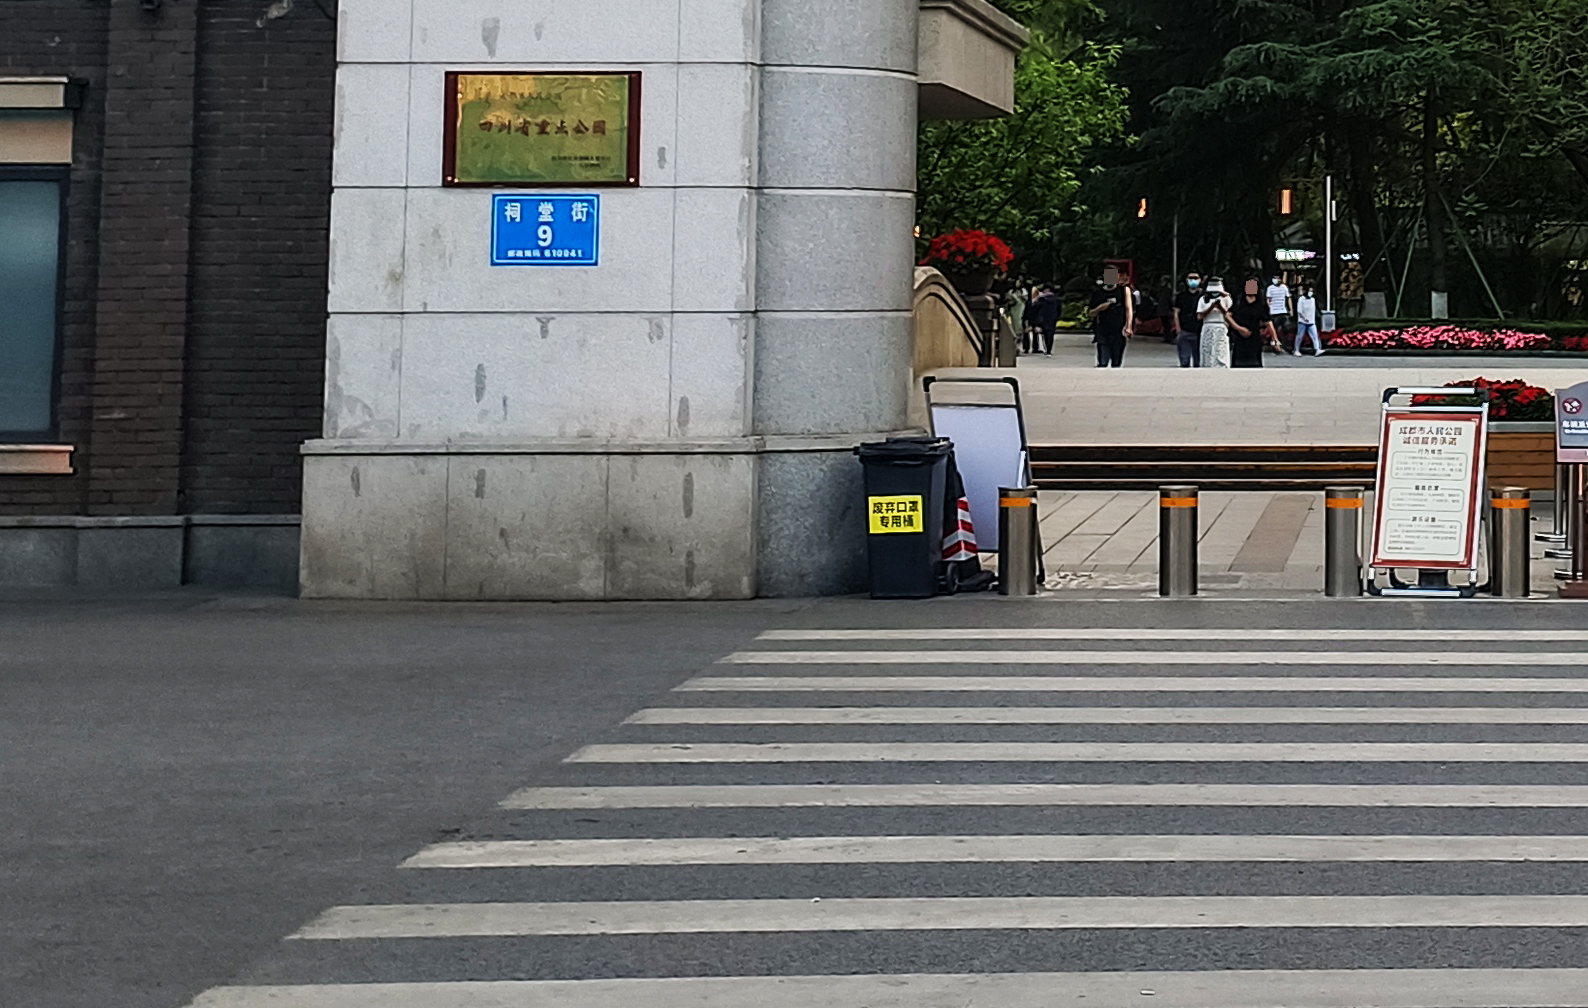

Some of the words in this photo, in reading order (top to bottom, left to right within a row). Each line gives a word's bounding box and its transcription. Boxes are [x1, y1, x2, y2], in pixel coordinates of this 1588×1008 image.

[504, 201, 588, 223] 祠堂街
[537, 224, 553, 247] 9
[873, 501, 919, 514] 废弃口罩
[879, 514, 914, 528] 专用桶
